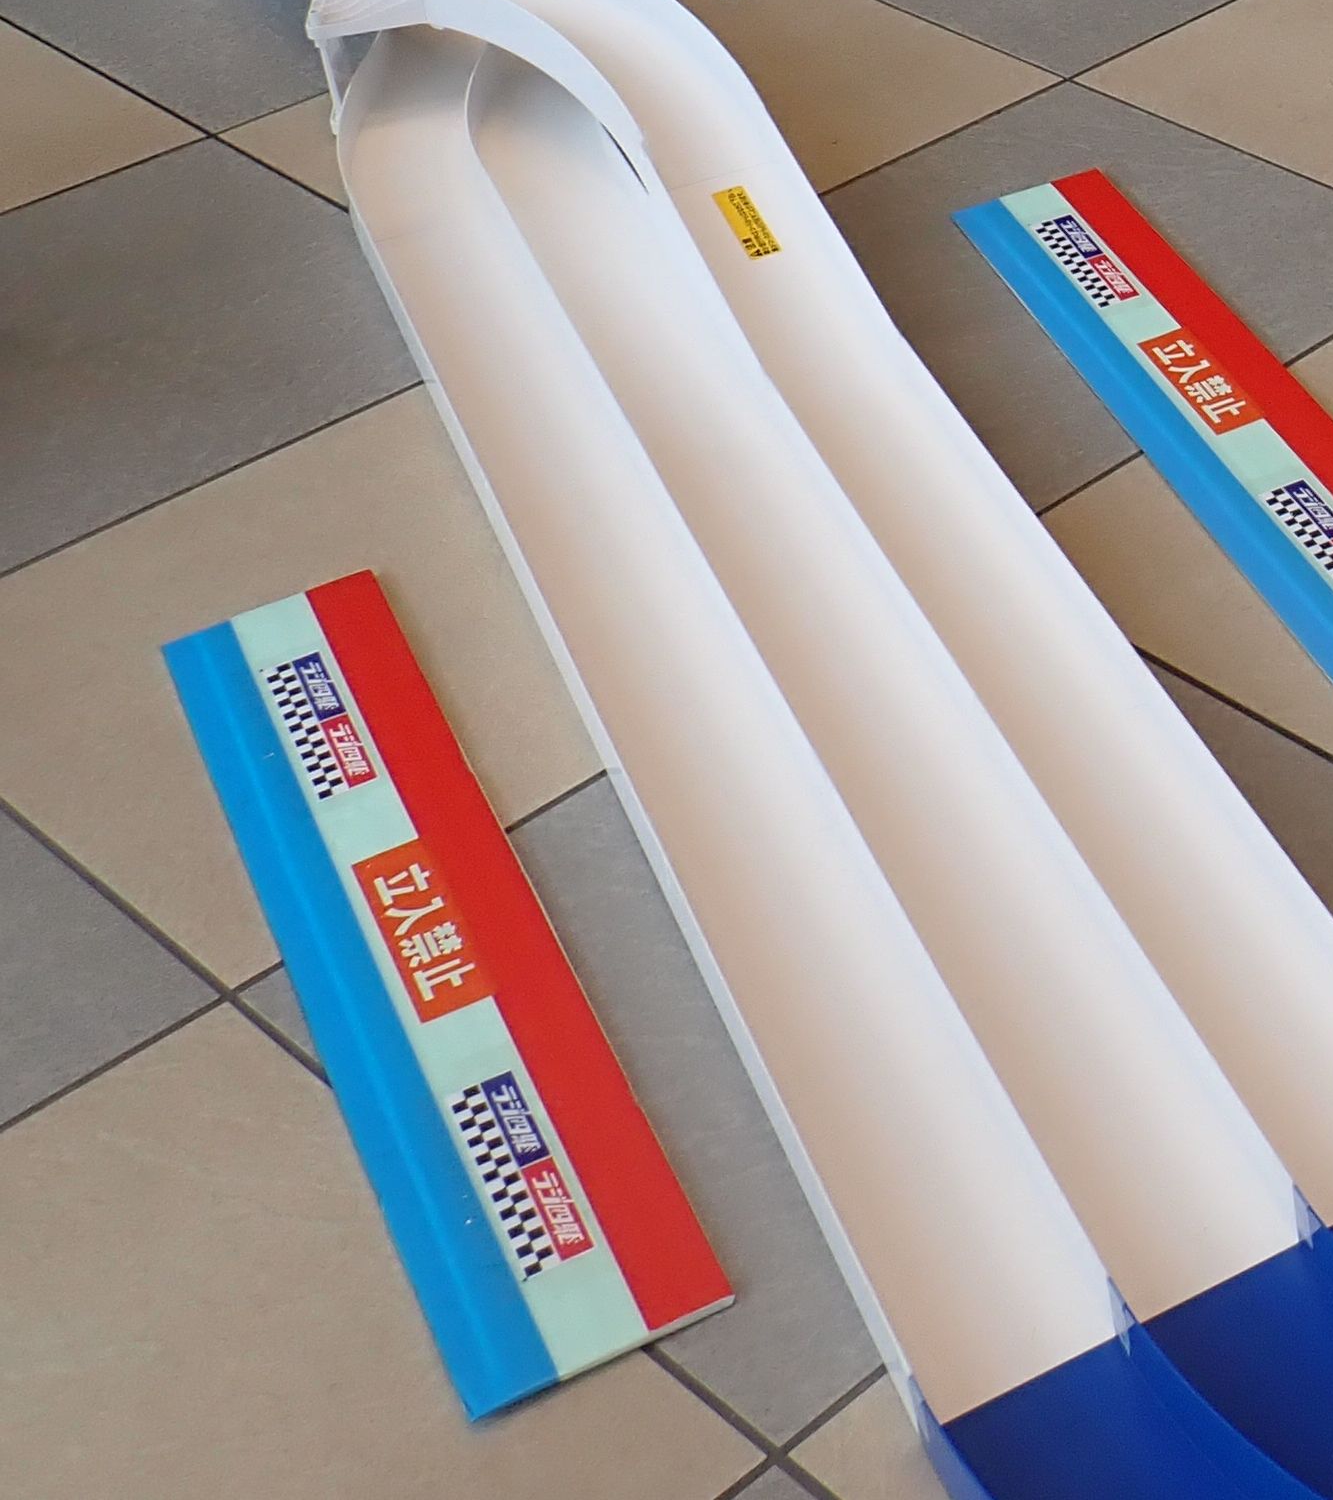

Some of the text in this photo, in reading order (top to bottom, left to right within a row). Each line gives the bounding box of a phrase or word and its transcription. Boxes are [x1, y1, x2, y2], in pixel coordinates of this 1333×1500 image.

[1152, 338, 1248, 424] 立入禁止
[370, 861, 476, 1004] 立入禁止
